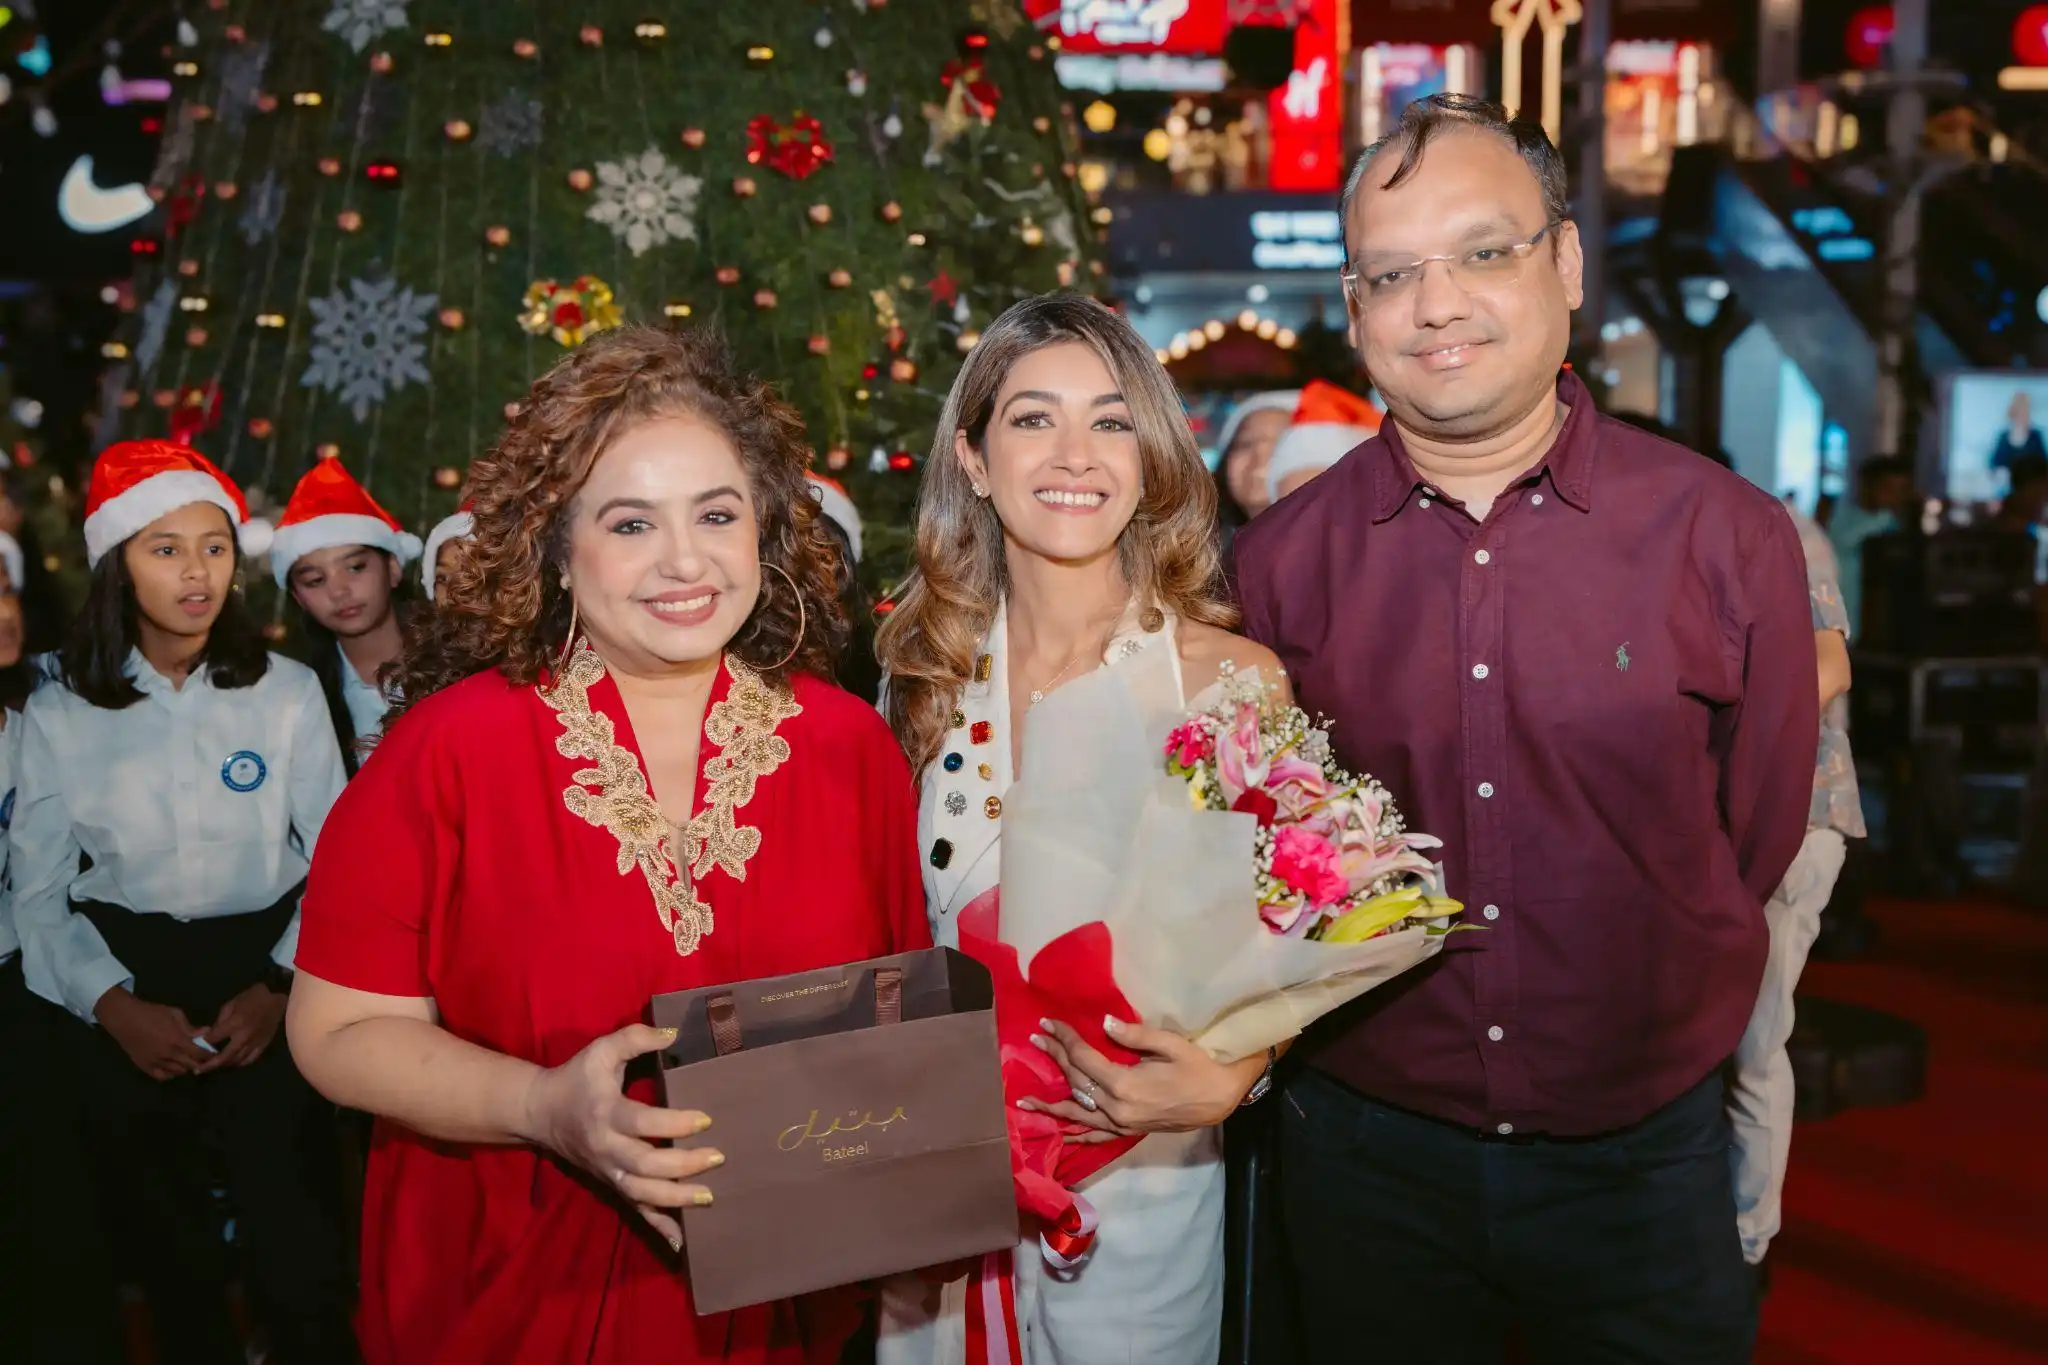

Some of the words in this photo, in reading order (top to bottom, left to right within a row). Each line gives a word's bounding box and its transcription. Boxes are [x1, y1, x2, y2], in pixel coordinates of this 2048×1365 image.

[760, 990, 794, 1003] DISCOVER
[794, 988, 809, 999] THE
[821, 1141, 870, 1162] Bateel
